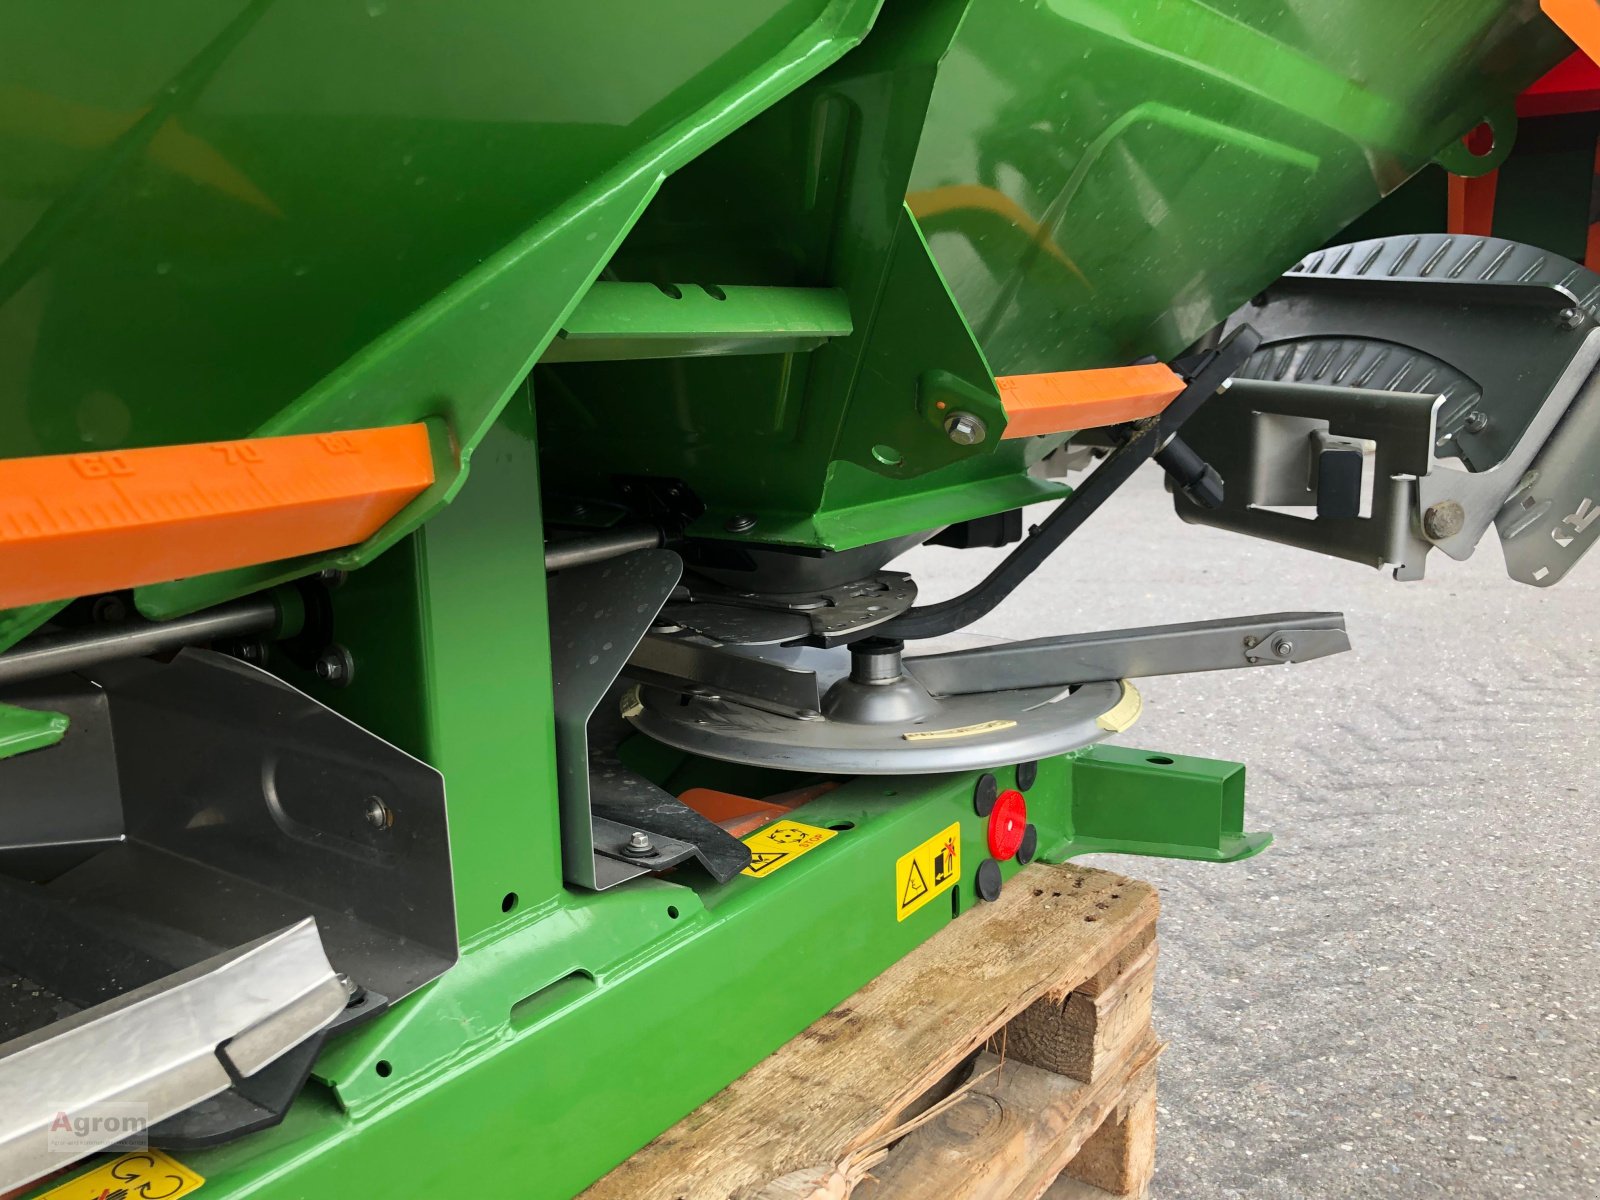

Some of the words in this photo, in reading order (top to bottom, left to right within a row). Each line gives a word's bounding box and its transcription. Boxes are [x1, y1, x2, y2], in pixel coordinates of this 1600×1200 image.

[69, 454, 136, 478] 60
[209, 444, 264, 465] 70
[315, 434, 361, 456] 80
[798, 833, 823, 848] STOP
